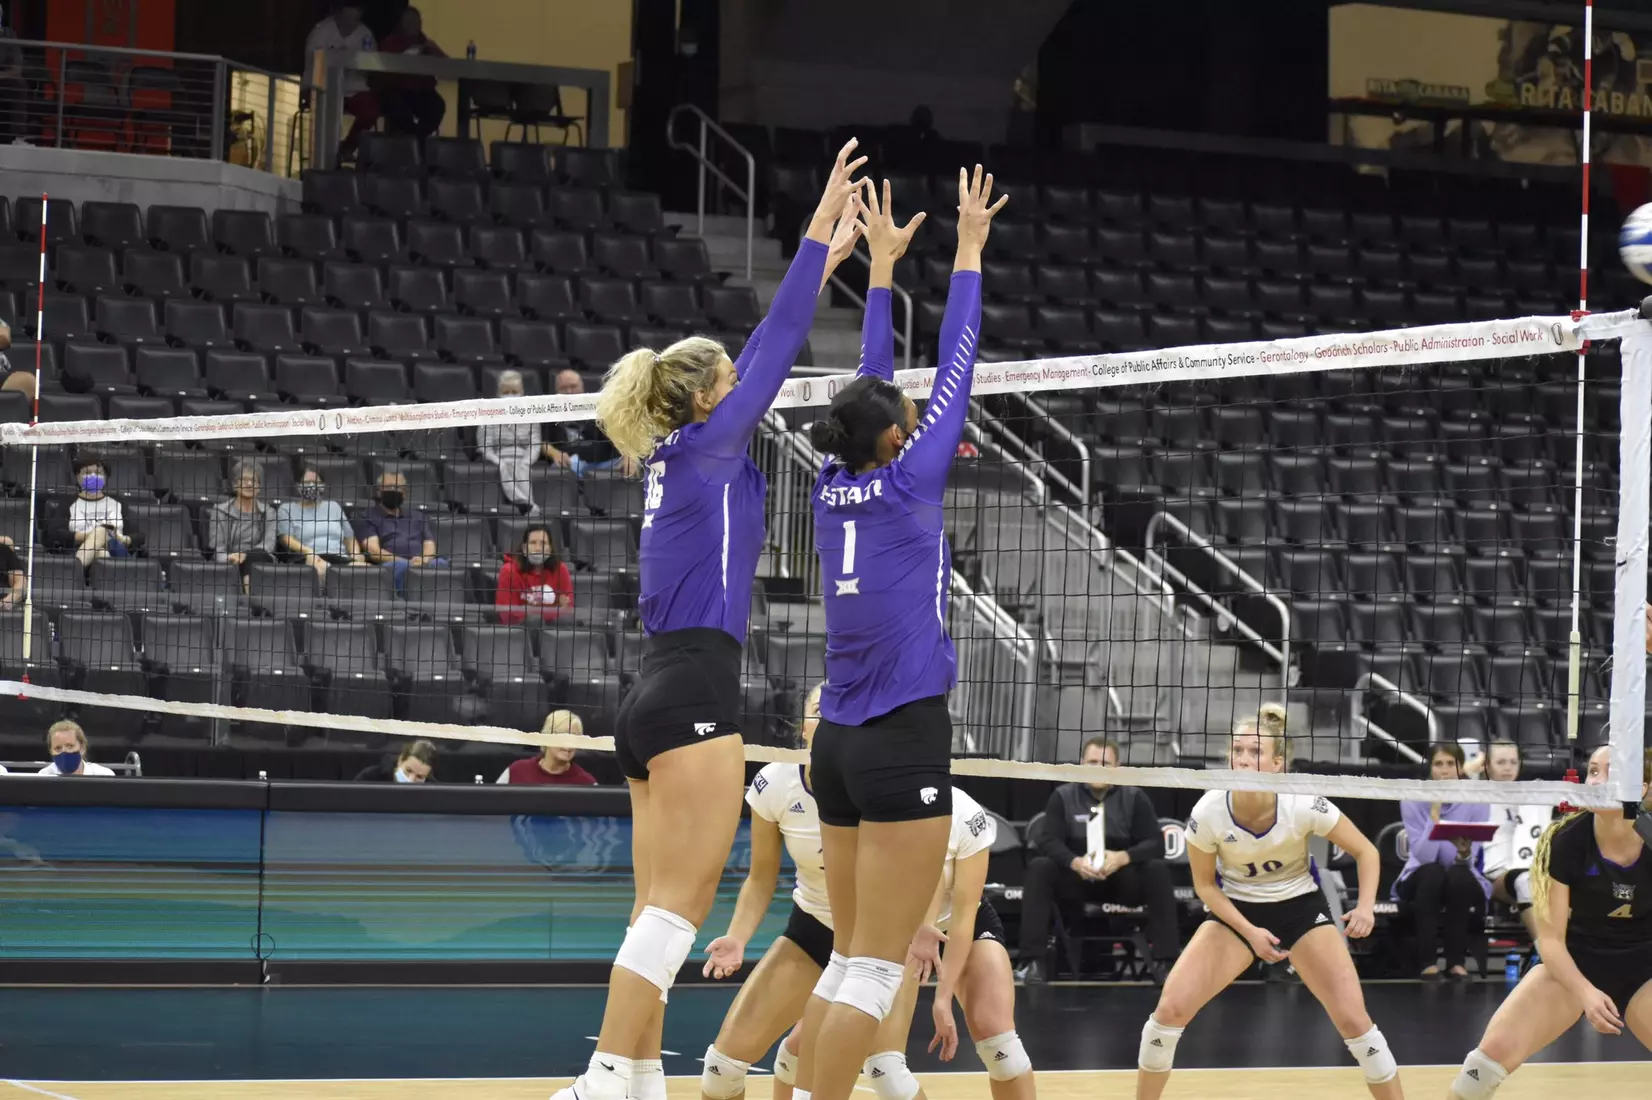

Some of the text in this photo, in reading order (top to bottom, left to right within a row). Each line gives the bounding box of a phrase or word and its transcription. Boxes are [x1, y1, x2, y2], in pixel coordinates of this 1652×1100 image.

[1521, 81, 1574, 109] RITA
[976, 372, 1001, 384] Studies
[1005, 369, 1041, 384] Emergency
[1092, 363, 1119, 378] College
[1120, 361, 1128, 374] of
[1128, 361, 1150, 373] Public
[1151, 357, 1177, 371] Affairs
[1178, 356, 1184, 369] &
[1227, 352, 1255, 366] Service
[1259, 348, 1309, 364] Gerontology
[1352, 341, 1388, 356] Scholars
[1393, 338, 1419, 352] Public
[1492, 329, 1519, 345] Social
[1520, 327, 1544, 342] Work
[842, 520, 856, 574] 1
[1606, 903, 1634, 919] 4
